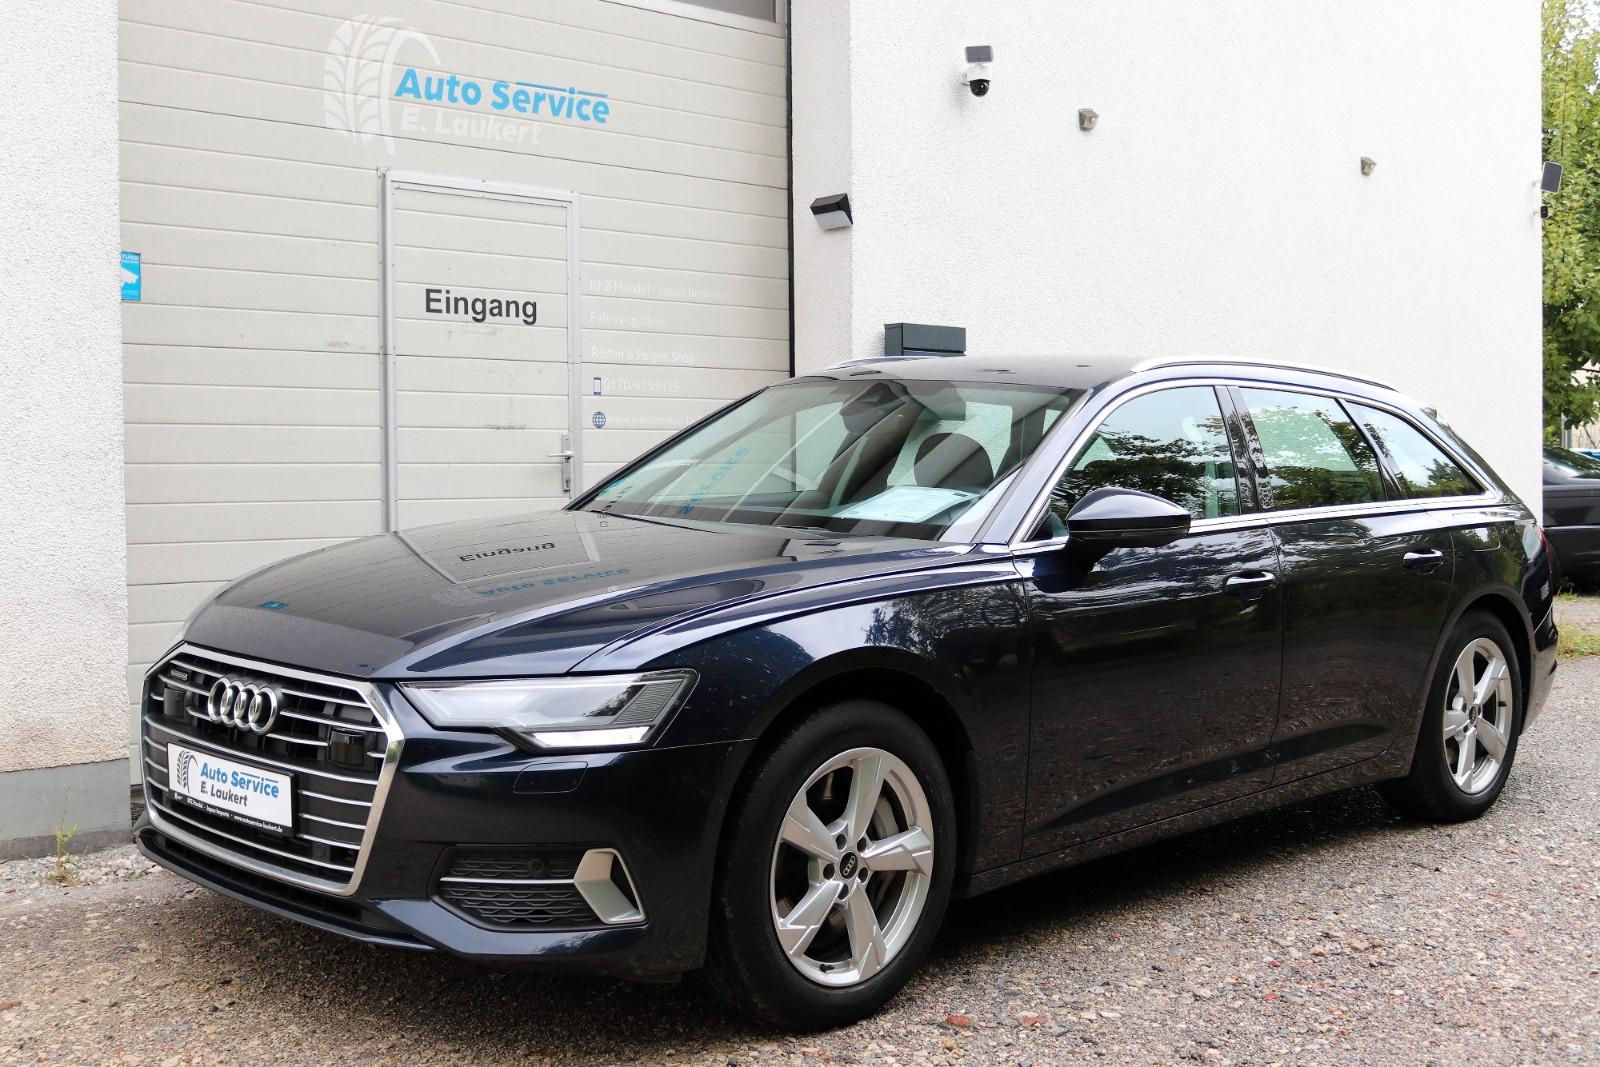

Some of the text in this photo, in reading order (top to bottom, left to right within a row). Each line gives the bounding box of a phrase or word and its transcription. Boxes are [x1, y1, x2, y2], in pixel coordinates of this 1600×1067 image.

[394, 67, 611, 124] Auto Service
[400, 107, 544, 145] E. Laukert
[590, 279, 613, 292] KFZ
[425, 288, 537, 326] Eingang
[591, 345, 696, 366] Reifen & Felgen Shop
[200, 762, 279, 798] Auto Service
[200, 781, 249, 807] E. Laukert
